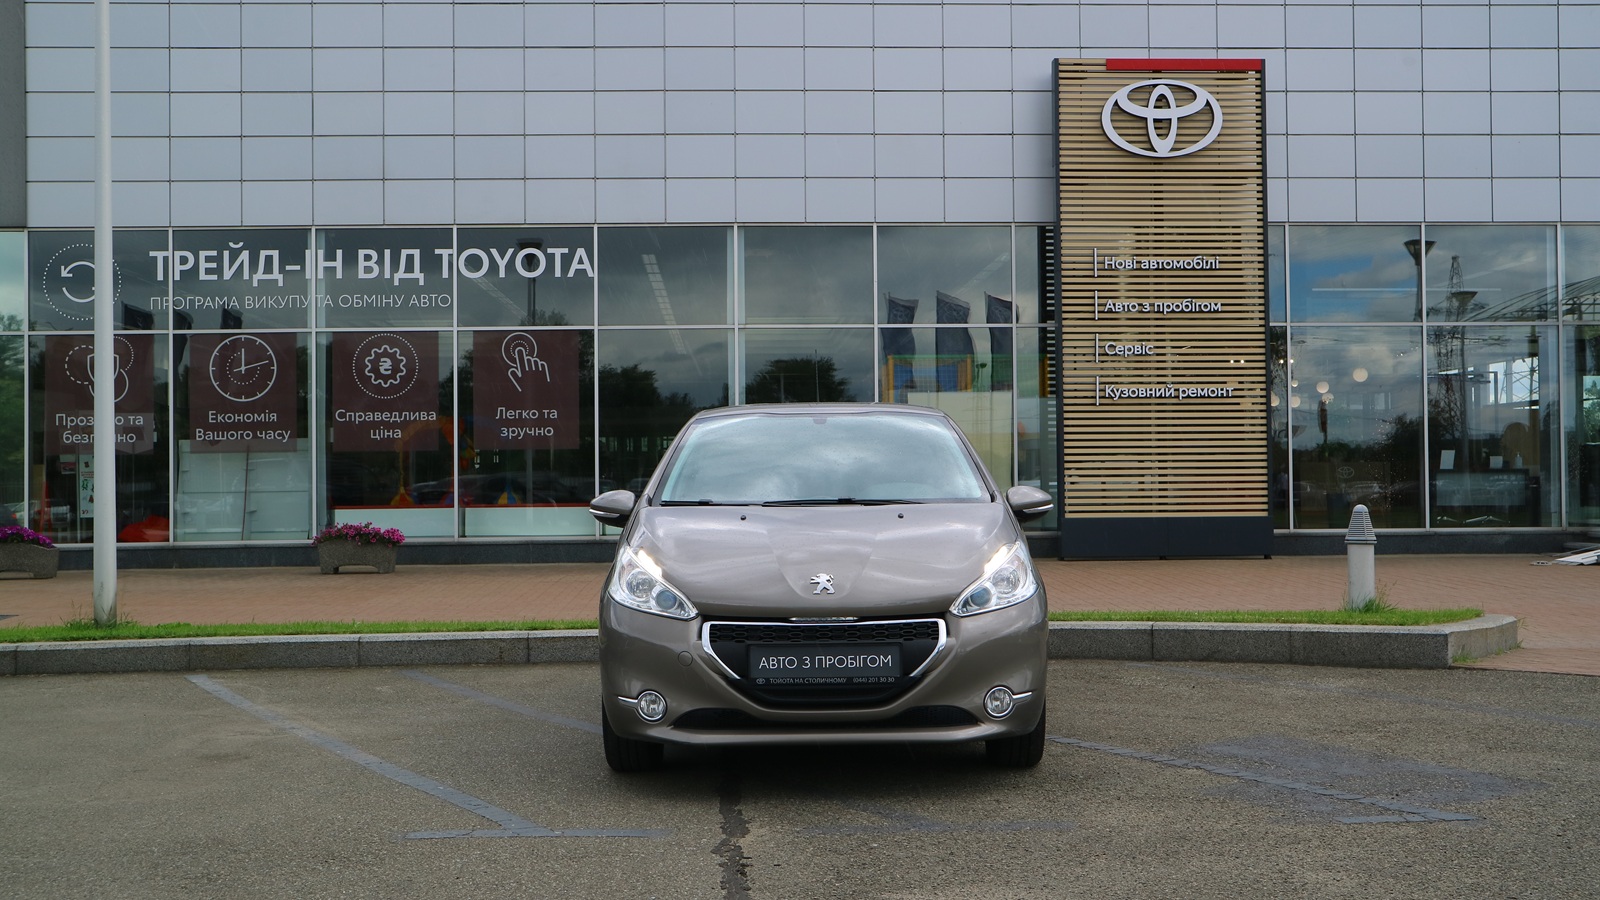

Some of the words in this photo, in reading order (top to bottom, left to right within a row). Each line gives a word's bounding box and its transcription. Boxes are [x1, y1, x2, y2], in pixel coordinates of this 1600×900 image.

[149, 241, 342, 287] ТРЕЙД-ІН
[357, 248, 425, 286] ВІД
[435, 247, 594, 279] TOYOTA
[1104, 256, 1137, 270] Нові
[1141, 256, 1220, 270] автомобілі
[150, 296, 240, 311] ПРОГРАМА
[245, 295, 311, 309] ВИКУПУ
[315, 294, 334, 308] ТА
[338, 294, 404, 308] ОБМІНУ
[409, 294, 452, 308] АВТО
[1104, 299, 1139, 313] Авто
[1142, 302, 1150, 313] з
[1154, 299, 1222, 315] пробігом
[1105, 342, 1155, 357] Сервіс
[1105, 385, 1175, 401] Кузовний
[1179, 387, 1234, 401] ремонт
[208, 410, 278, 423] Економія
[335, 409, 437, 424] Справедлива
[495, 407, 539, 420] Легко
[542, 409, 558, 420] та
[55, 413, 125, 430] Прозо
[128, 415, 144, 426] та
[62, 430, 137, 444] безно
[195, 428, 253, 442] Вашого
[256, 430, 291, 443] часу
[370, 425, 402, 440] ціна
[500, 425, 554, 438] зручно
[758, 656, 797, 669] АВТО
[815, 655, 892, 668] ПРОБІГОМ
